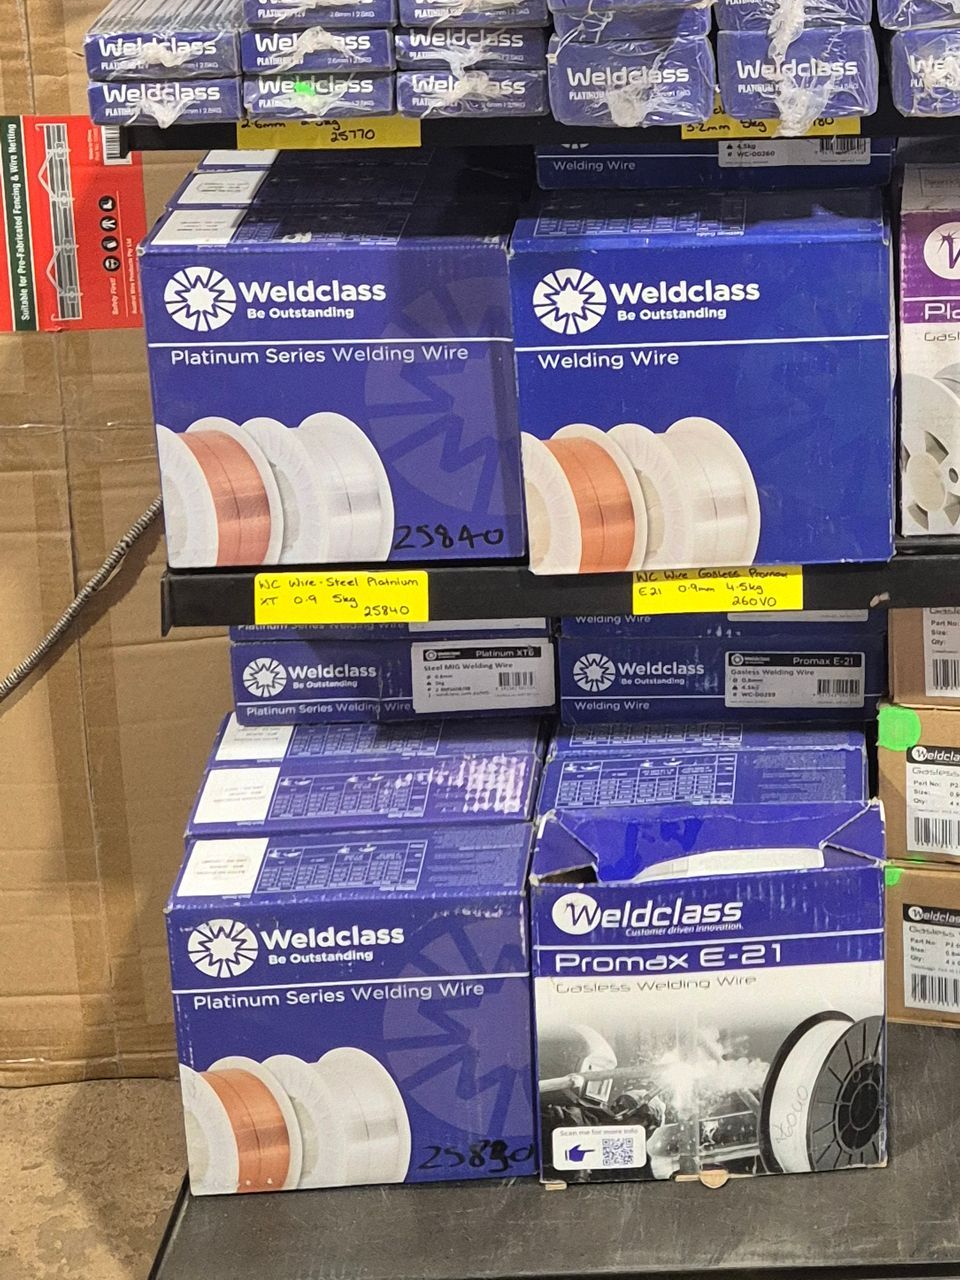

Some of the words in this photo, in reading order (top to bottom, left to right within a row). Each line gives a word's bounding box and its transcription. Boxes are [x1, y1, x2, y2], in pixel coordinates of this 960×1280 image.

[553, 160, 603, 172] Welding
[607, 159, 636, 171] Wire
[239, 280, 386, 303] Weldclass
[609, 280, 760, 304] Weldclass
[19, 288, 30, 321] Suitable
[247, 308, 265, 319] Be
[269, 306, 355, 320] Outstanding
[617, 310, 635, 321] Be
[640, 307, 726, 321] Outstanding
[171, 348, 259, 365] Platinum
[266, 347, 326, 364] Series
[331, 346, 415, 364] Welding
[421, 345, 469, 360] Wire
[537, 352, 624, 370] Welding
[630, 350, 679, 366] Wire
[394, 524, 505, 550] 25840
[364, 604, 409, 616] 25840
[288, 664, 376, 680] Weldclass
[618, 661, 704, 676] Weldclass
[247, 704, 296, 716] Platinum
[298, 703, 333, 714] Series
[335, 702, 381, 714] Welding
[574, 700, 619, 712] Welding
[622, 699, 649, 710] Wire
[557, 893, 743, 933] Weldclass
[260, 926, 405, 950] Weldclass
[269, 954, 287, 965] Be
[290, 950, 373, 964] Outstanding
[555, 951, 688, 973] Promax
[699, 943, 782, 967] E-21
[637, 978, 711, 992] Welding
[716, 973, 757, 986] Wire
[194, 993, 280, 1011] Platinum
[286, 990, 345, 1005] Series
[351, 984, 432, 1002] Welding
[438, 982, 484, 997] Wire
